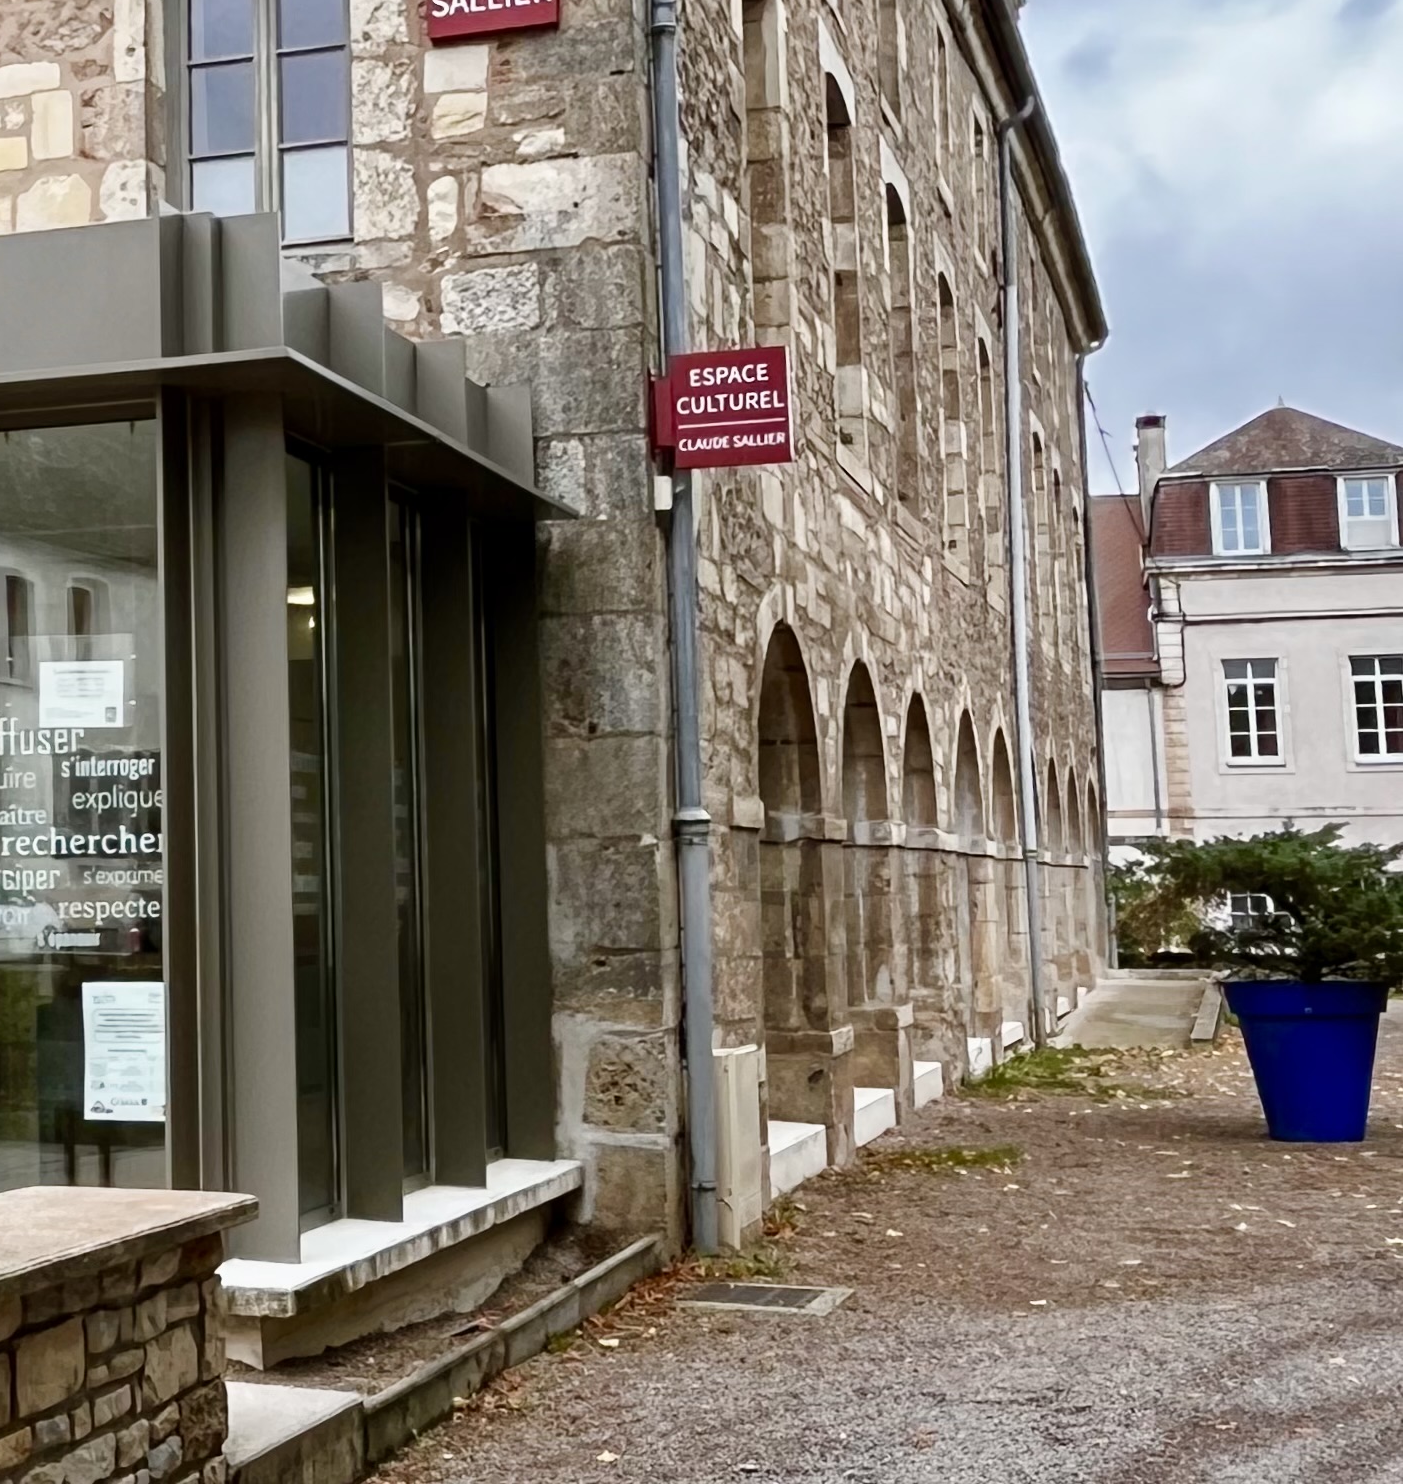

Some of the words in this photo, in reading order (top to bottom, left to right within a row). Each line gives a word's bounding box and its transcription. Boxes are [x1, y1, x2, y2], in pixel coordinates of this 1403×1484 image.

[689, 363, 769, 388] ESPACE
[676, 390, 785, 415] CULTUREL
[678, 435, 731, 452] CLAUDE
[733, 431, 786, 448] SALLIER
[61, 755, 156, 780] s'interroger
[58, 897, 161, 925] respecte
